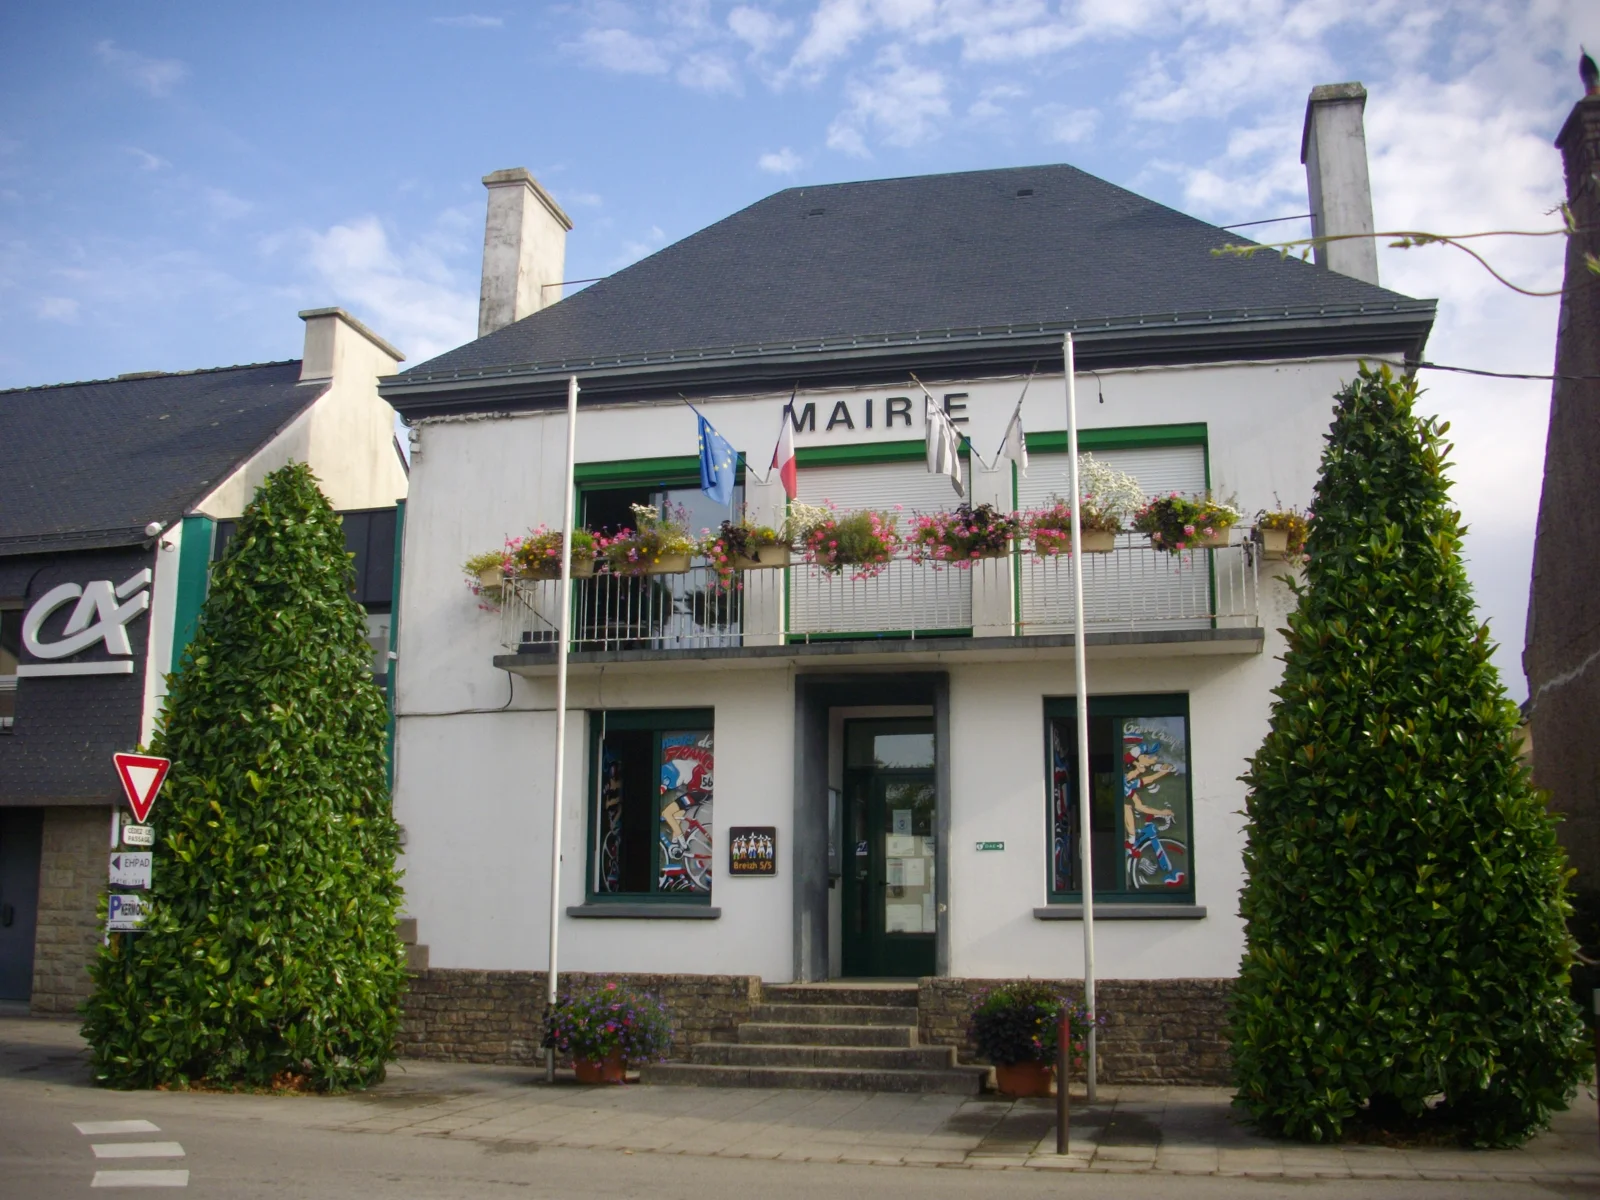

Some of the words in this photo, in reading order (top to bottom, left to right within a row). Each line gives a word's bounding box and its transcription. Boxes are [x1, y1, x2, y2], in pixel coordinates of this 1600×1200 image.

[698, 733, 714, 749] de
[702, 776, 713, 788] 56
[128, 835, 150, 843] PASSAGE
[124, 858, 150, 868] EHPAD
[733, 861, 758, 870] Breizh
[759, 861, 772, 871] 5/5
